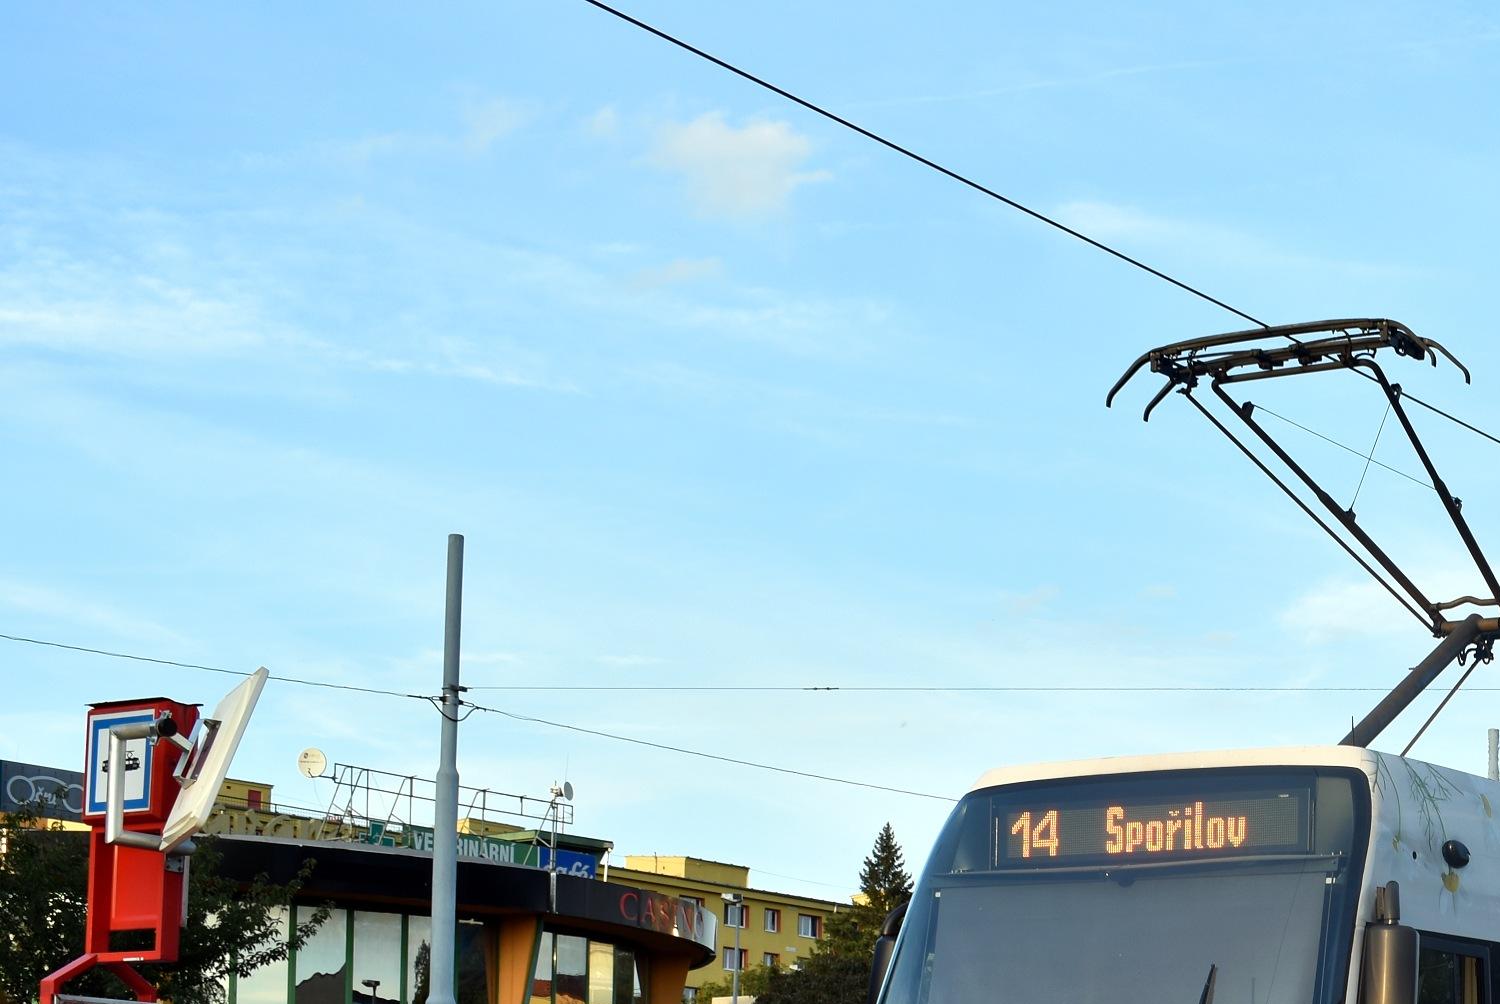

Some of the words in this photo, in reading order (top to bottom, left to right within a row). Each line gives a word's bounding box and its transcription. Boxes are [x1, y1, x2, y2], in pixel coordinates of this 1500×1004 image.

[413, 829, 515, 864] VERINÁRNÍ
[1011, 811, 1058, 858] 14
[1106, 801, 1246, 854] Spořilov
